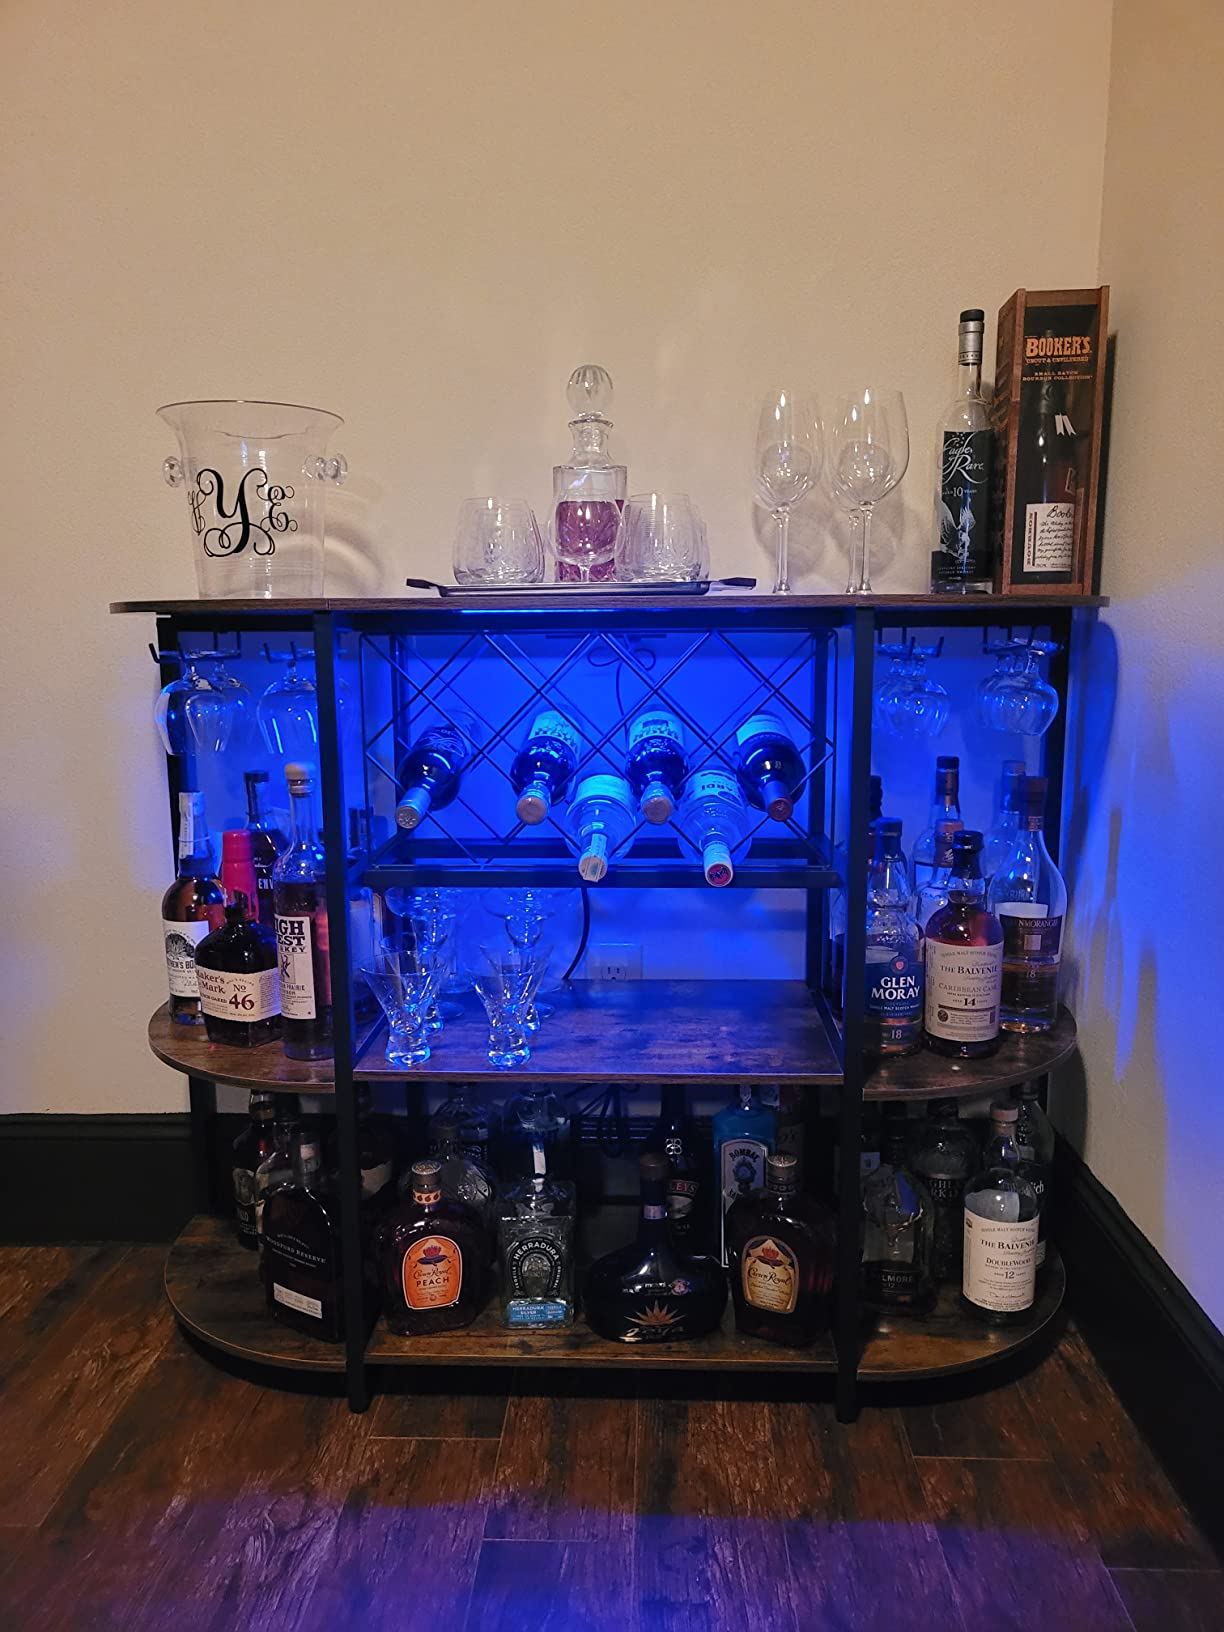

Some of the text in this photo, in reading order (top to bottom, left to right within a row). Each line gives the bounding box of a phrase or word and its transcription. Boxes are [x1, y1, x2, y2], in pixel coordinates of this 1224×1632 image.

[1026, 336, 1091, 357] BOOKER'S
[953, 486, 963, 497] 10
[940, 965, 956, 973] THE
[880, 975, 915, 988] GLEN
[871, 985, 920, 1000] MORAY
[938, 983, 982, 993] CARIBBEAN
[229, 993, 254, 1010] 46
[963, 998, 976, 1006] 14
[891, 1029, 902, 1039] 18
[728, 1148, 760, 1162] BOMBAY
[981, 1239, 996, 1247] THE
[513, 1241, 559, 1260] HERRADURA
[986, 1257, 1031, 1266] DOUBLEWOOD
[1004, 1271, 1015, 1279] 12
[416, 1276, 449, 1287] PEACH
